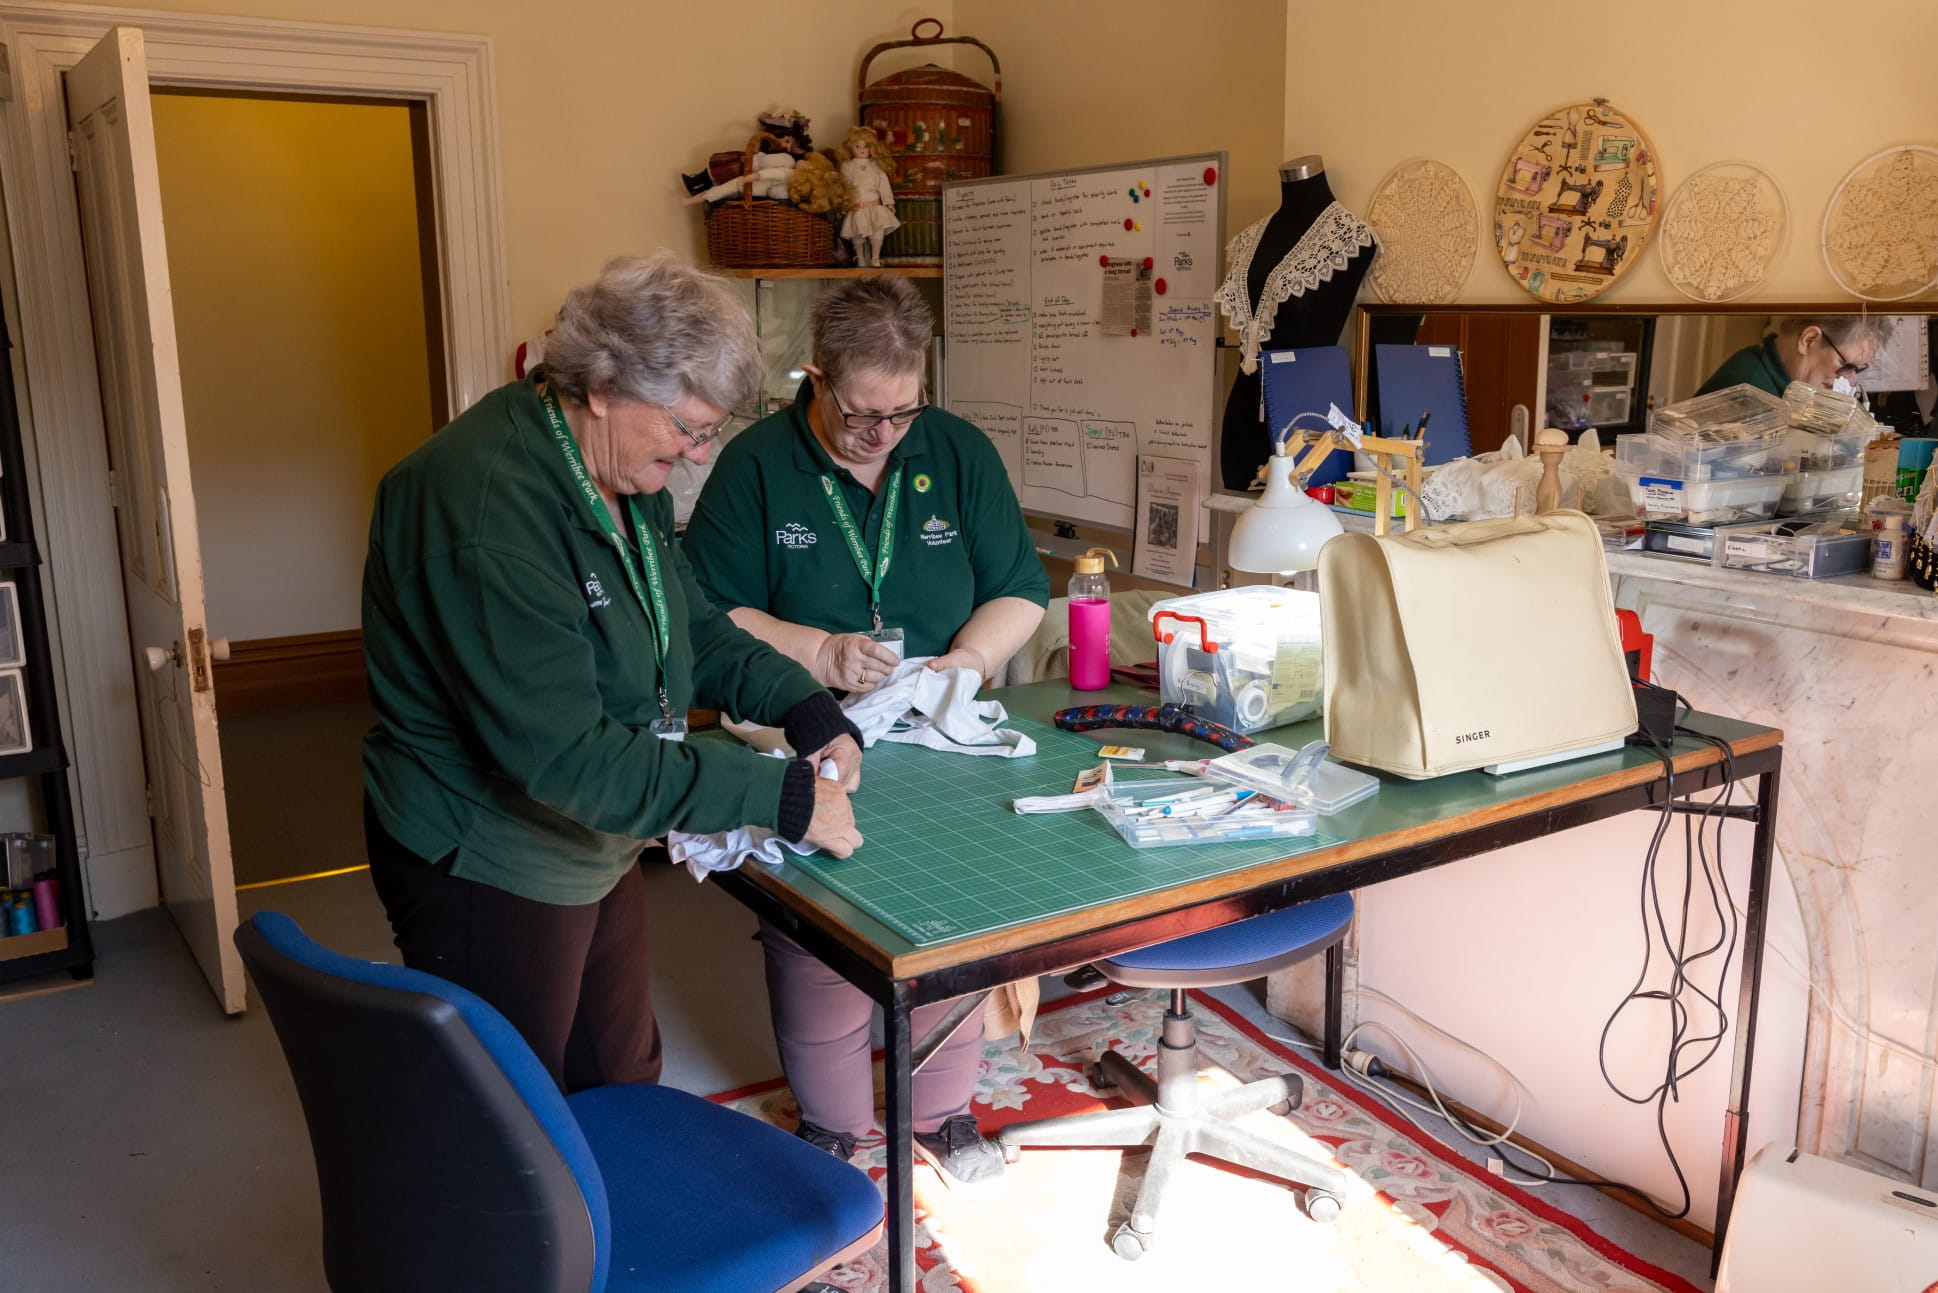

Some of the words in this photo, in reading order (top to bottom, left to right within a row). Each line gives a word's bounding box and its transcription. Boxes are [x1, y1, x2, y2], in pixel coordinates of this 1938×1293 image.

[1174, 256, 1193, 267] Parks
[543, 396, 563, 429] Friends
[555, 429, 569, 440] of
[561, 440, 586, 481] Werribee
[580, 479, 599, 506] Park
[775, 530, 817, 545] Parks
[833, 495, 849, 521] Friends
[842, 521, 854, 530] of
[848, 528, 864, 559] Werribee
[860, 558, 872, 579] Park
[920, 533, 943, 541] Werribee
[945, 530, 958, 538] Park
[927, 538, 952, 547] Volunteer
[1456, 730, 1491, 744] SINGER
